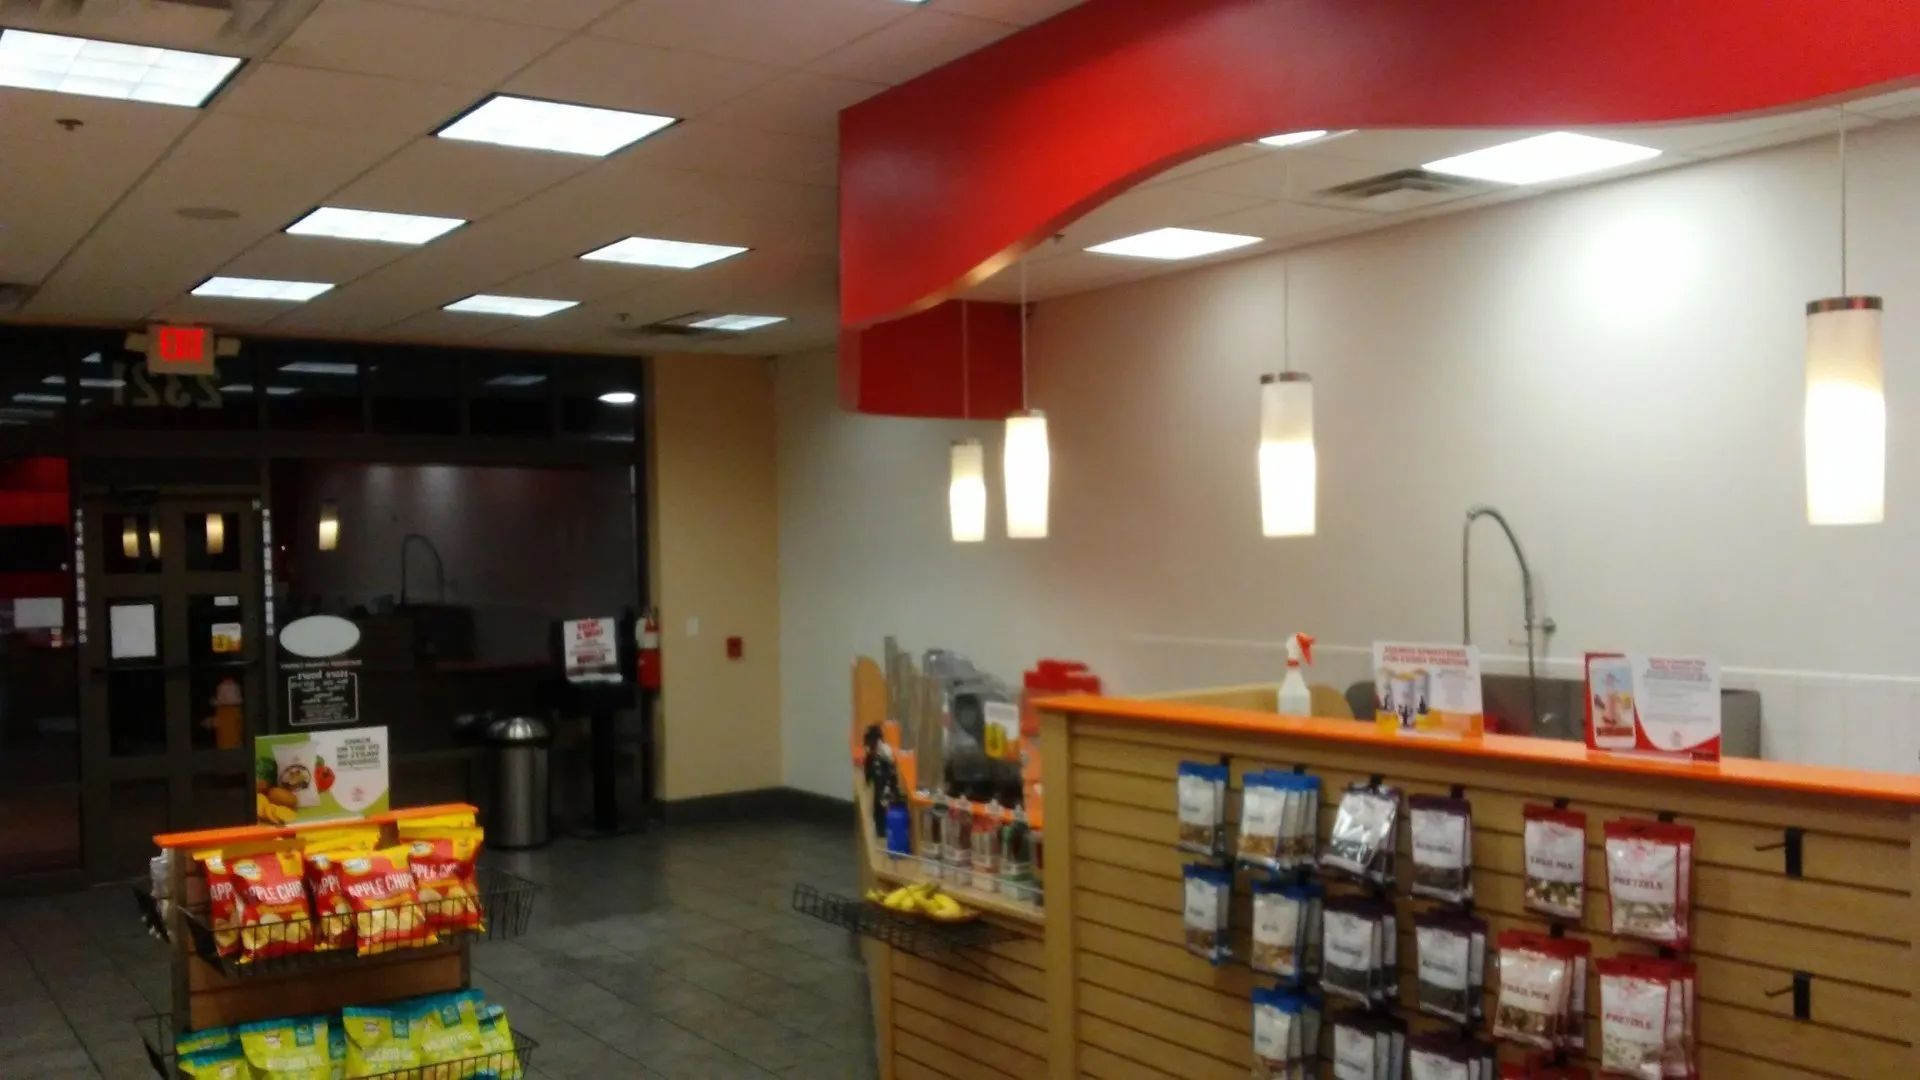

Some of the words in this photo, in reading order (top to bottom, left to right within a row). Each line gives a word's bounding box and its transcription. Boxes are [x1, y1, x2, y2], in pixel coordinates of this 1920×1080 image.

[159, 327, 204, 361] EXIT
[347, 877, 386, 899] APPLE
[1613, 876, 1663, 890] PRETZELS
[1606, 1012, 1652, 1030] PRETZELS
